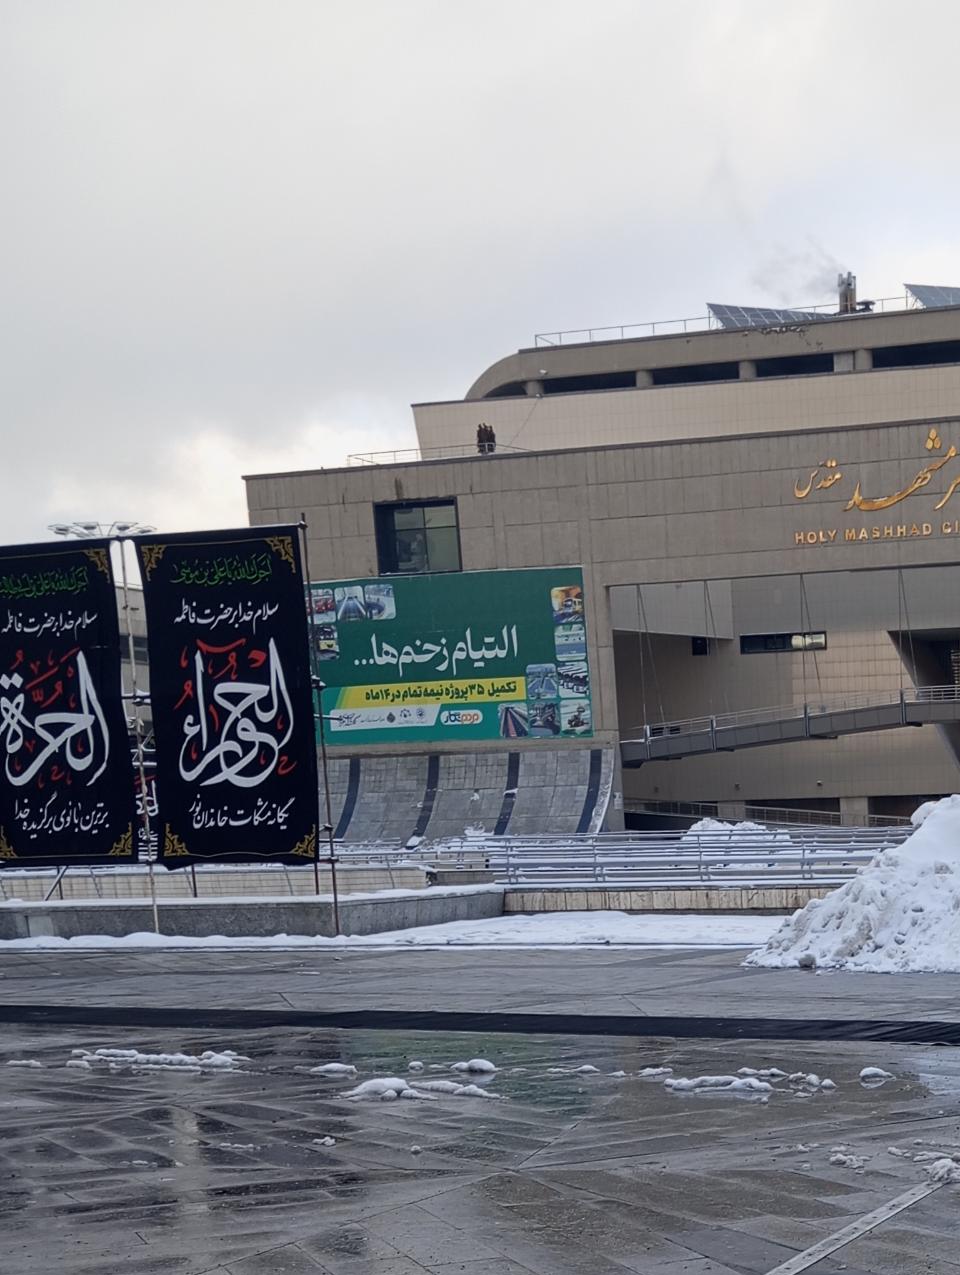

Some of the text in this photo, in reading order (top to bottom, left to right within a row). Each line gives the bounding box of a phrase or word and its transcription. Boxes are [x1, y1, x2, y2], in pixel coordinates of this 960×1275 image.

[794, 458, 842, 498] مقدس
[843, 427, 957, 512] مشهد
[794, 529, 837, 545] HOLY
[845, 522, 932, 541] MASHHAD
[1, 608, 22, 633] فاطمه
[23, 612, 55, 638] حضرت
[60, 610, 75, 631] خدا
[75, 610, 98, 640] سلام
[174, 598, 279, 634] سلام خدا بر حضرت فاطمه
[452, 624, 519, 675] التیام
[402, 686, 422, 702] تمام
[423, 685, 443, 700] نیمه
[445, 684, 469, 701] پروژه
[469, 683, 485, 695] ۳۵
[488, 680, 517, 697] تکمیل
[14, 798, 30, 820] خدا
[52, 801, 81, 832] بانوی
[188, 793, 202, 816] نور
[80, 802, 109, 834] برترین
[193, 805, 228, 829] خاندان
